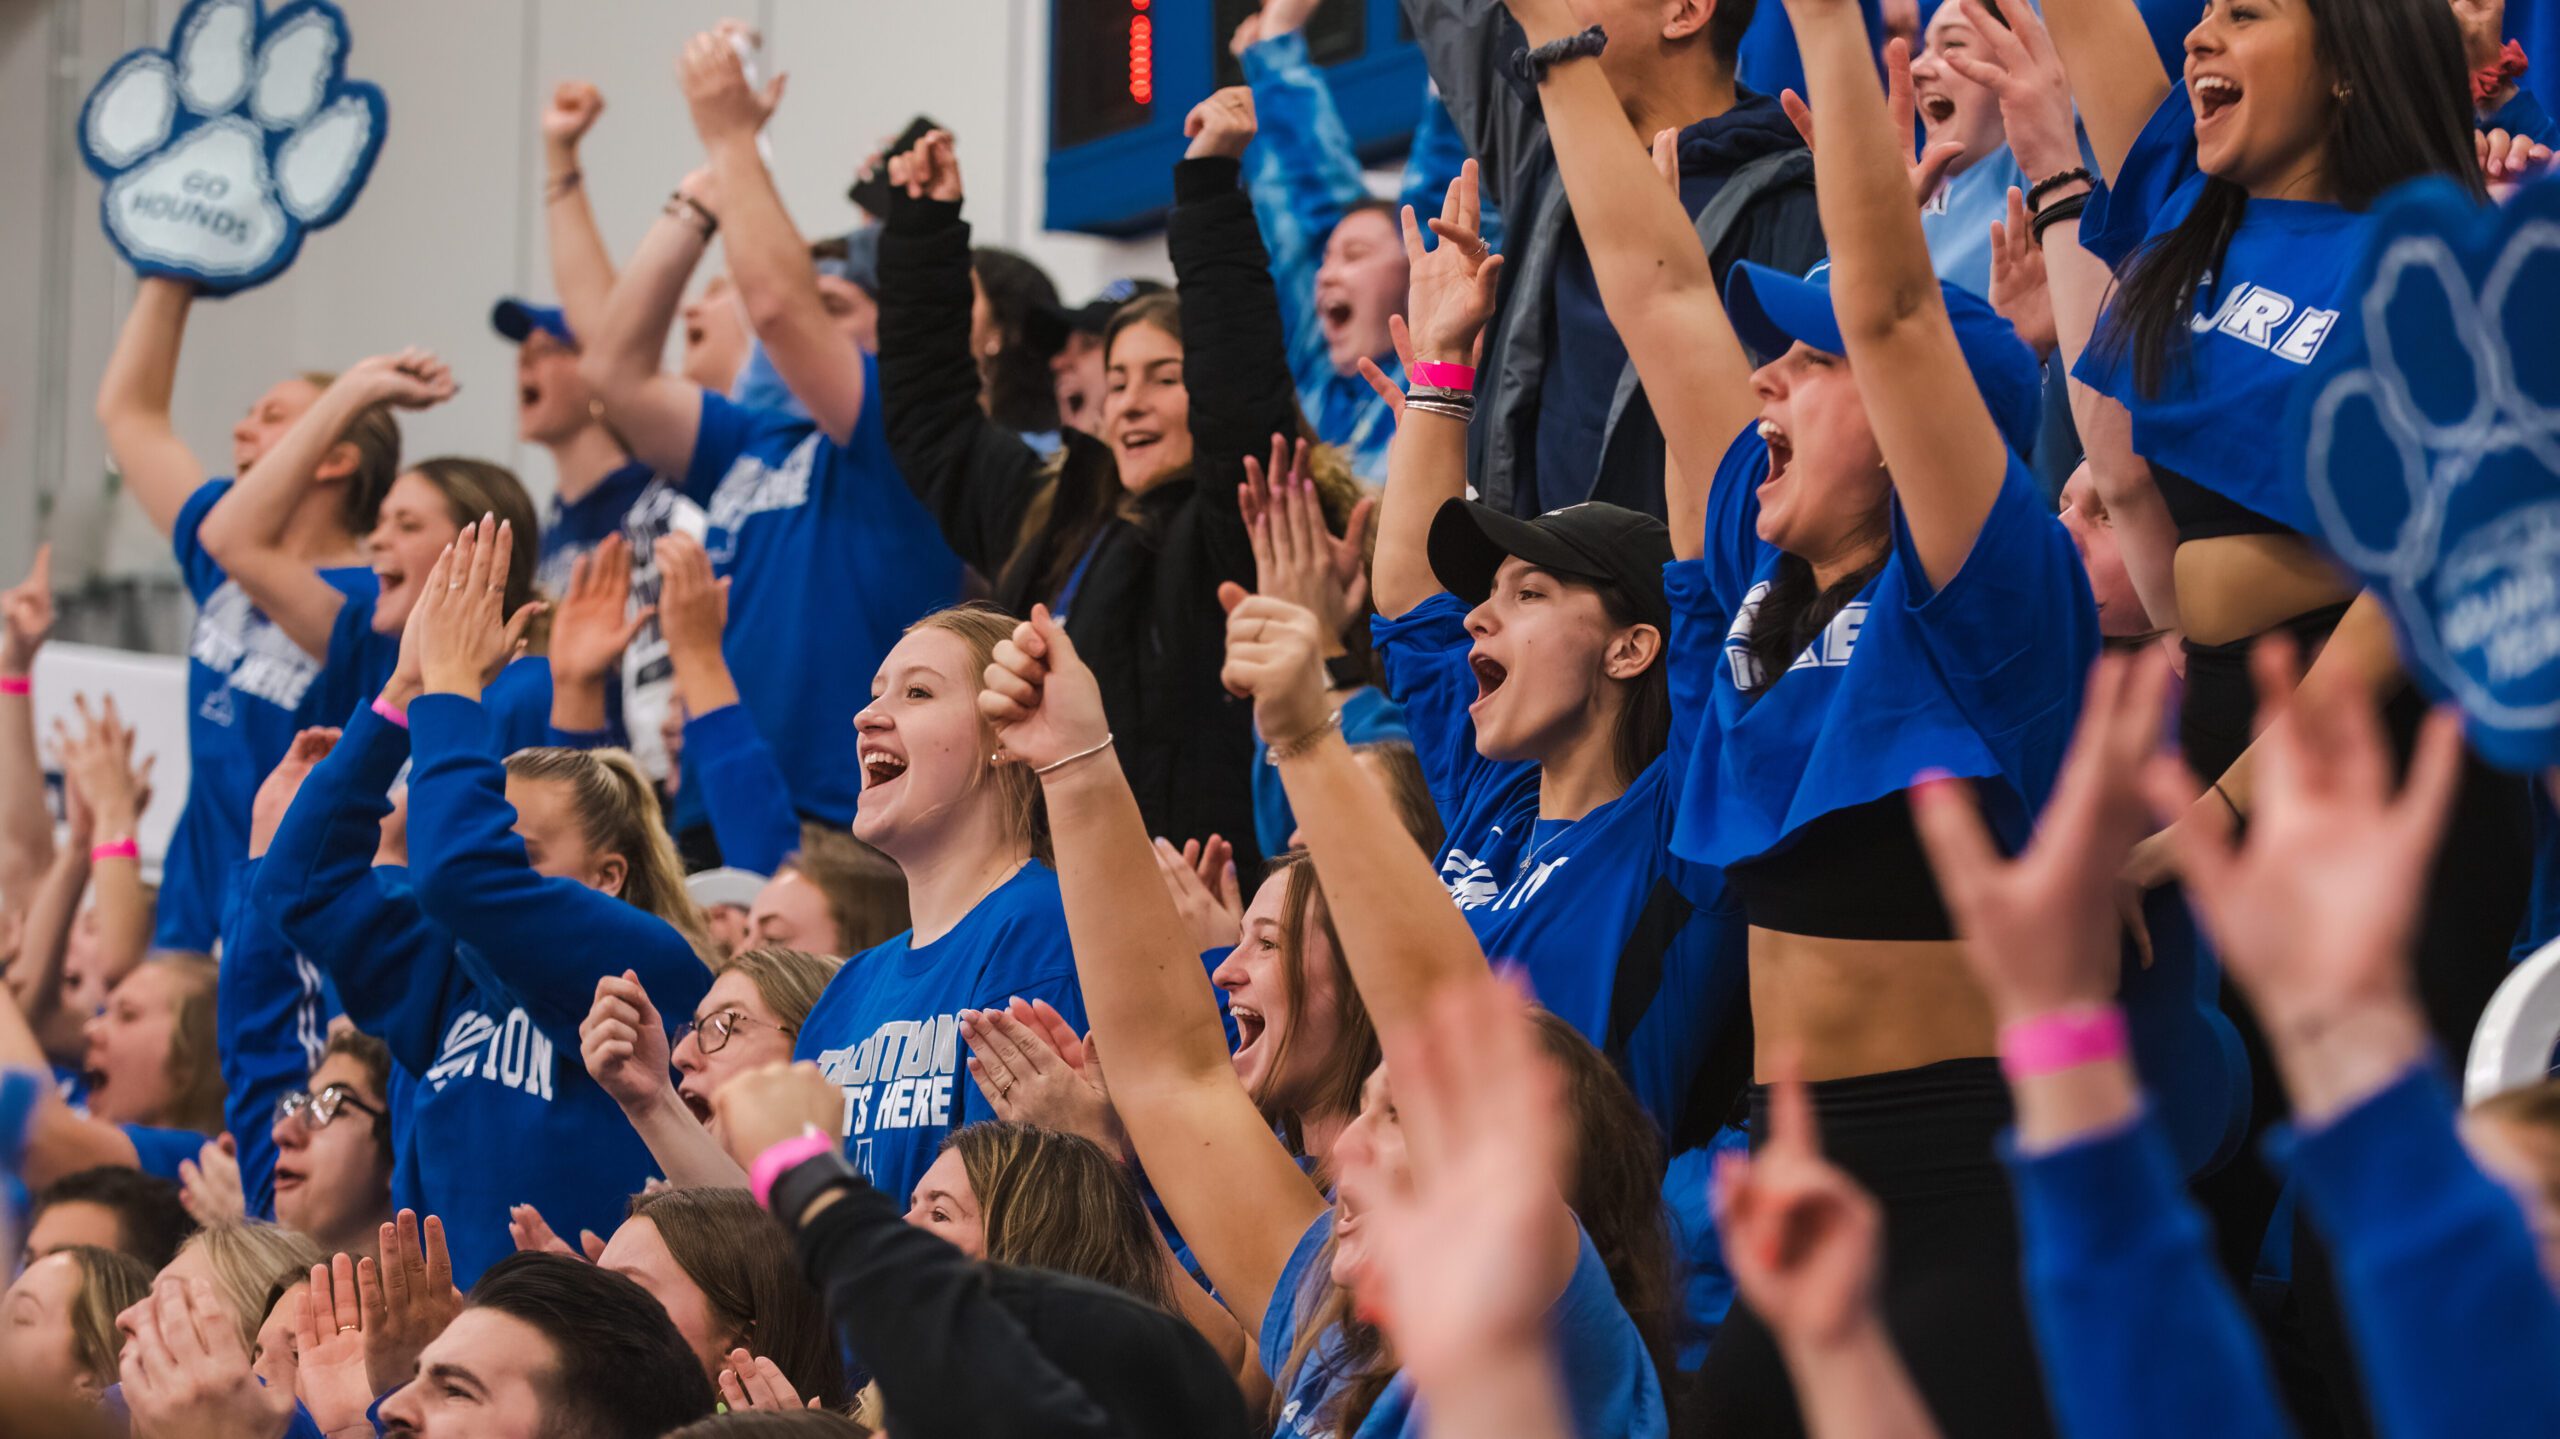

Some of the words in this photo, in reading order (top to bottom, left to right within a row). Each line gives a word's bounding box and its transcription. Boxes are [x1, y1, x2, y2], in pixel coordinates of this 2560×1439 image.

[182, 169, 230, 201] GO
[131, 192, 249, 245] HOUNDS
[874, 1075, 953, 1131] HERE
